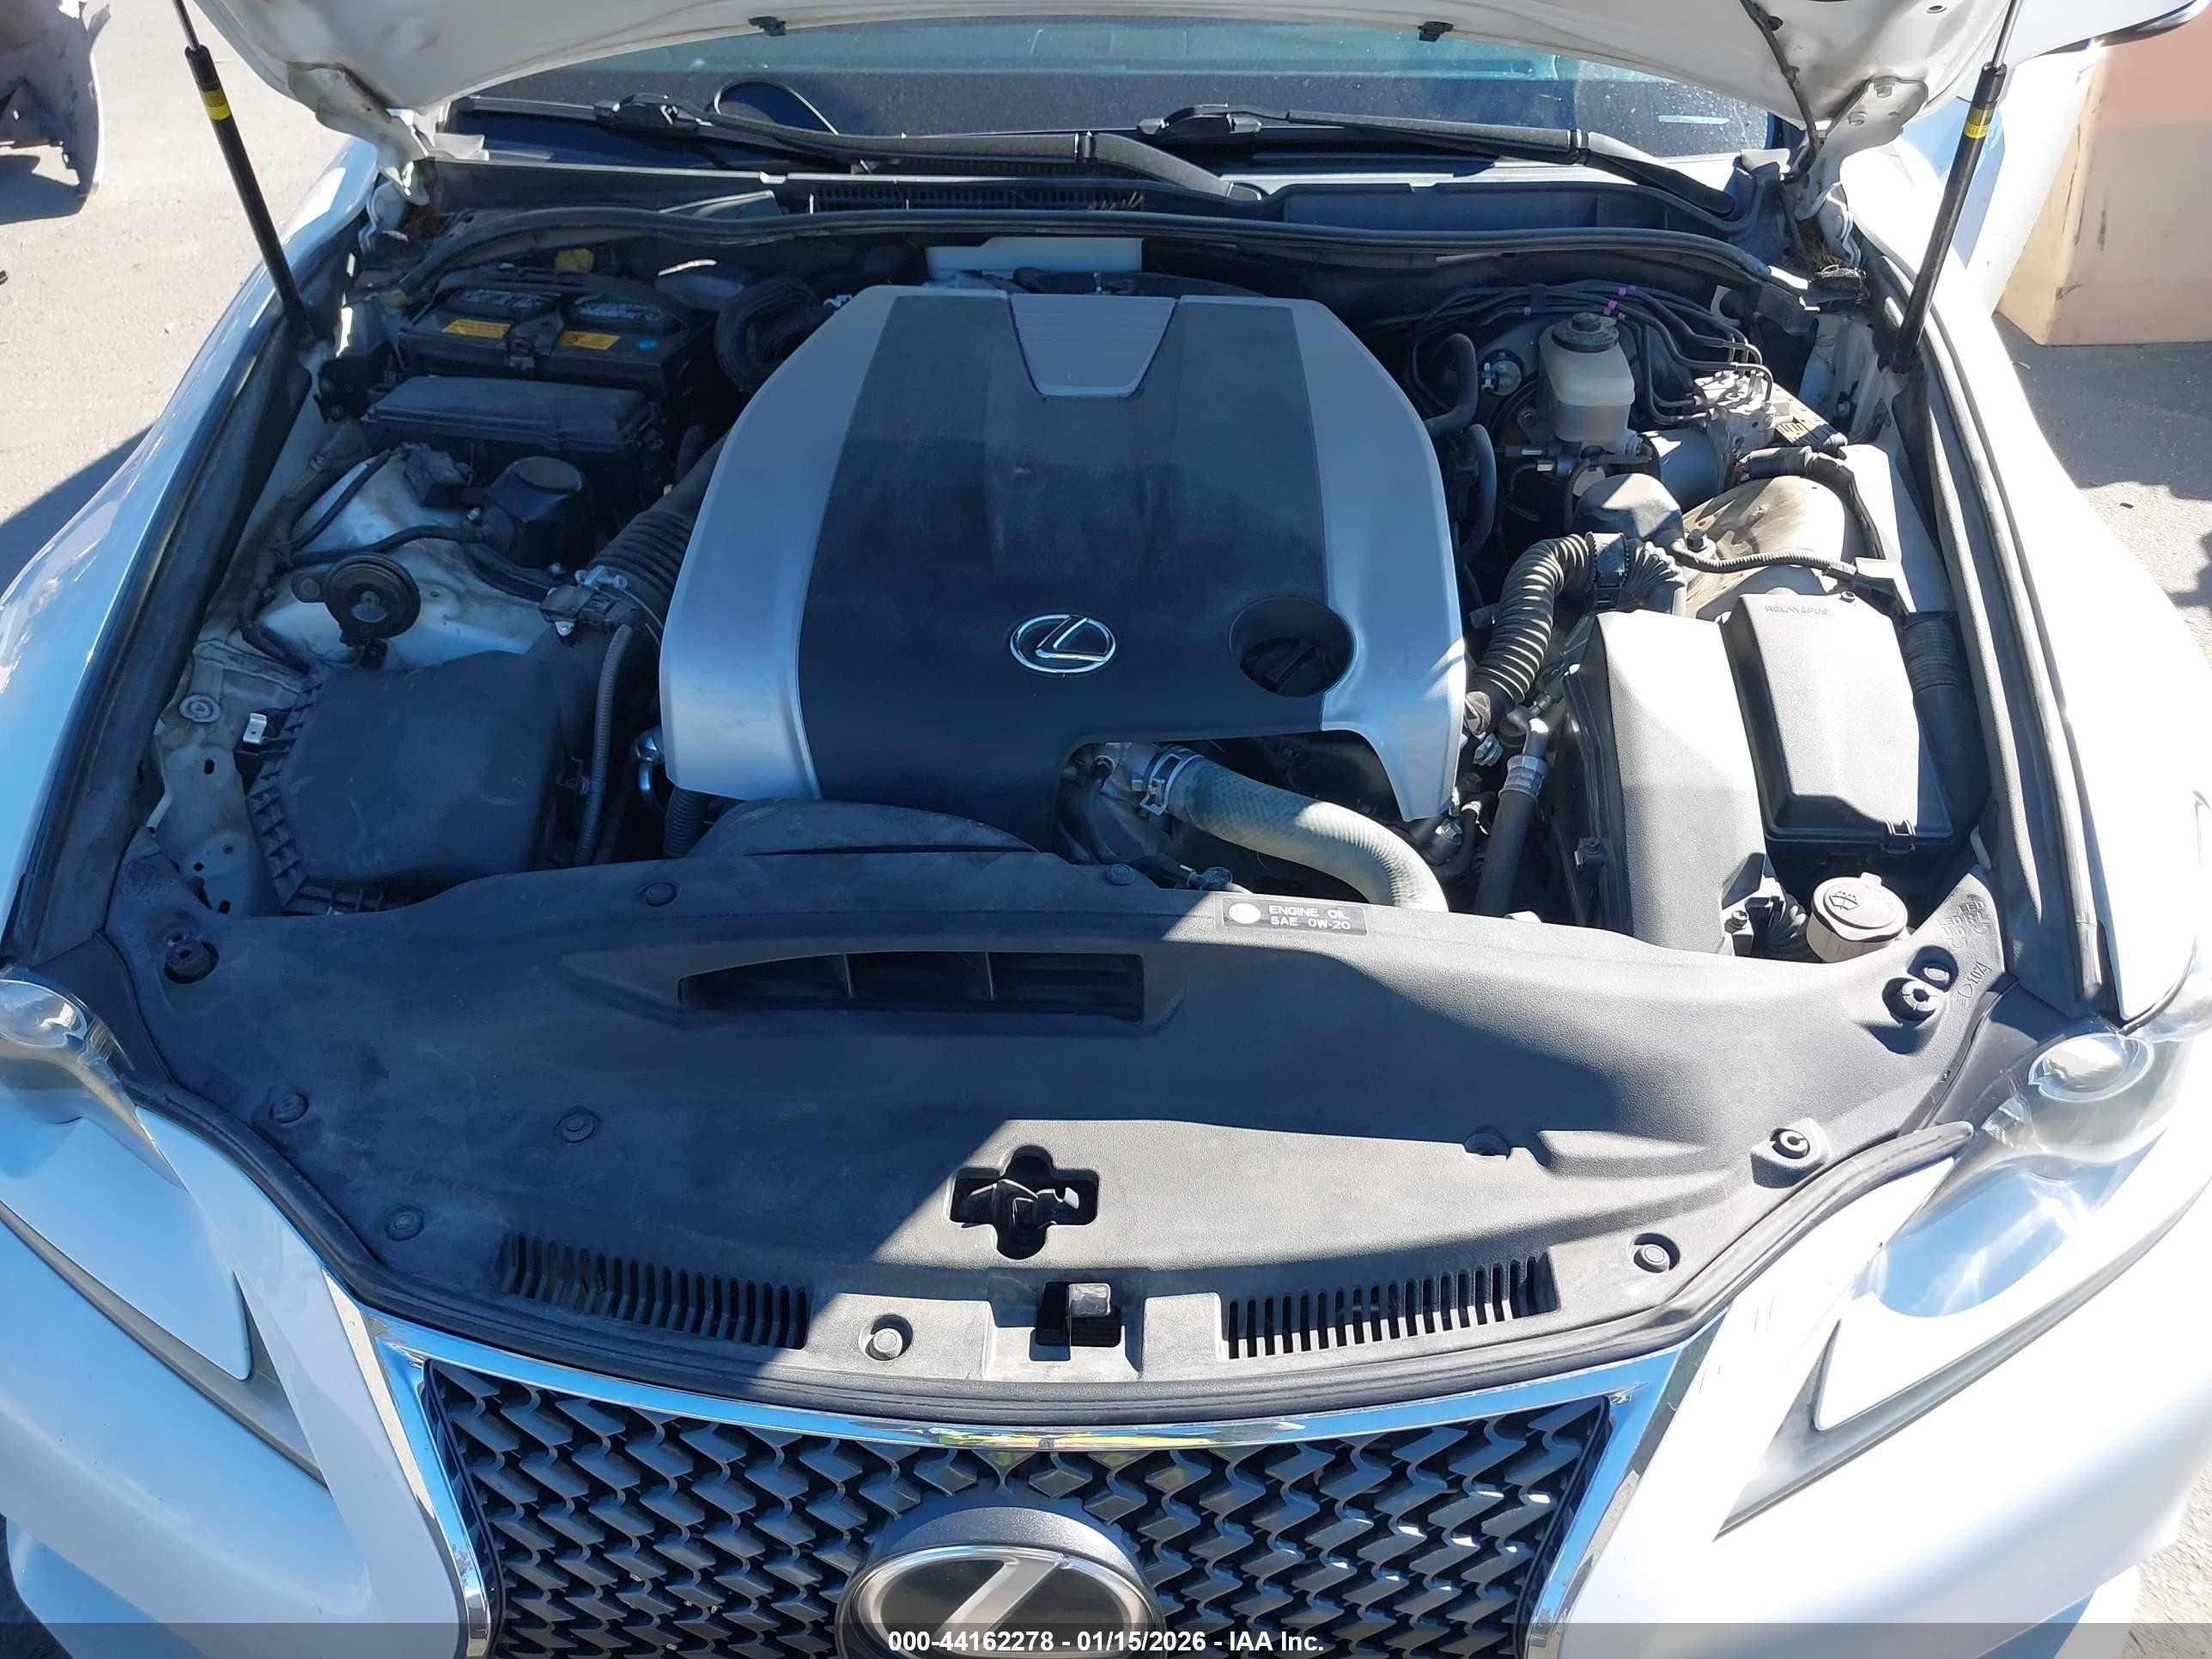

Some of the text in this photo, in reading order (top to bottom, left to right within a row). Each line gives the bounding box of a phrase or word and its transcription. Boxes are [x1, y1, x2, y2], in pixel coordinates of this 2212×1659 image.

[1268, 905, 1350, 920] ENGINE OIL
[1270, 915, 1351, 930] SAE 0W-20
